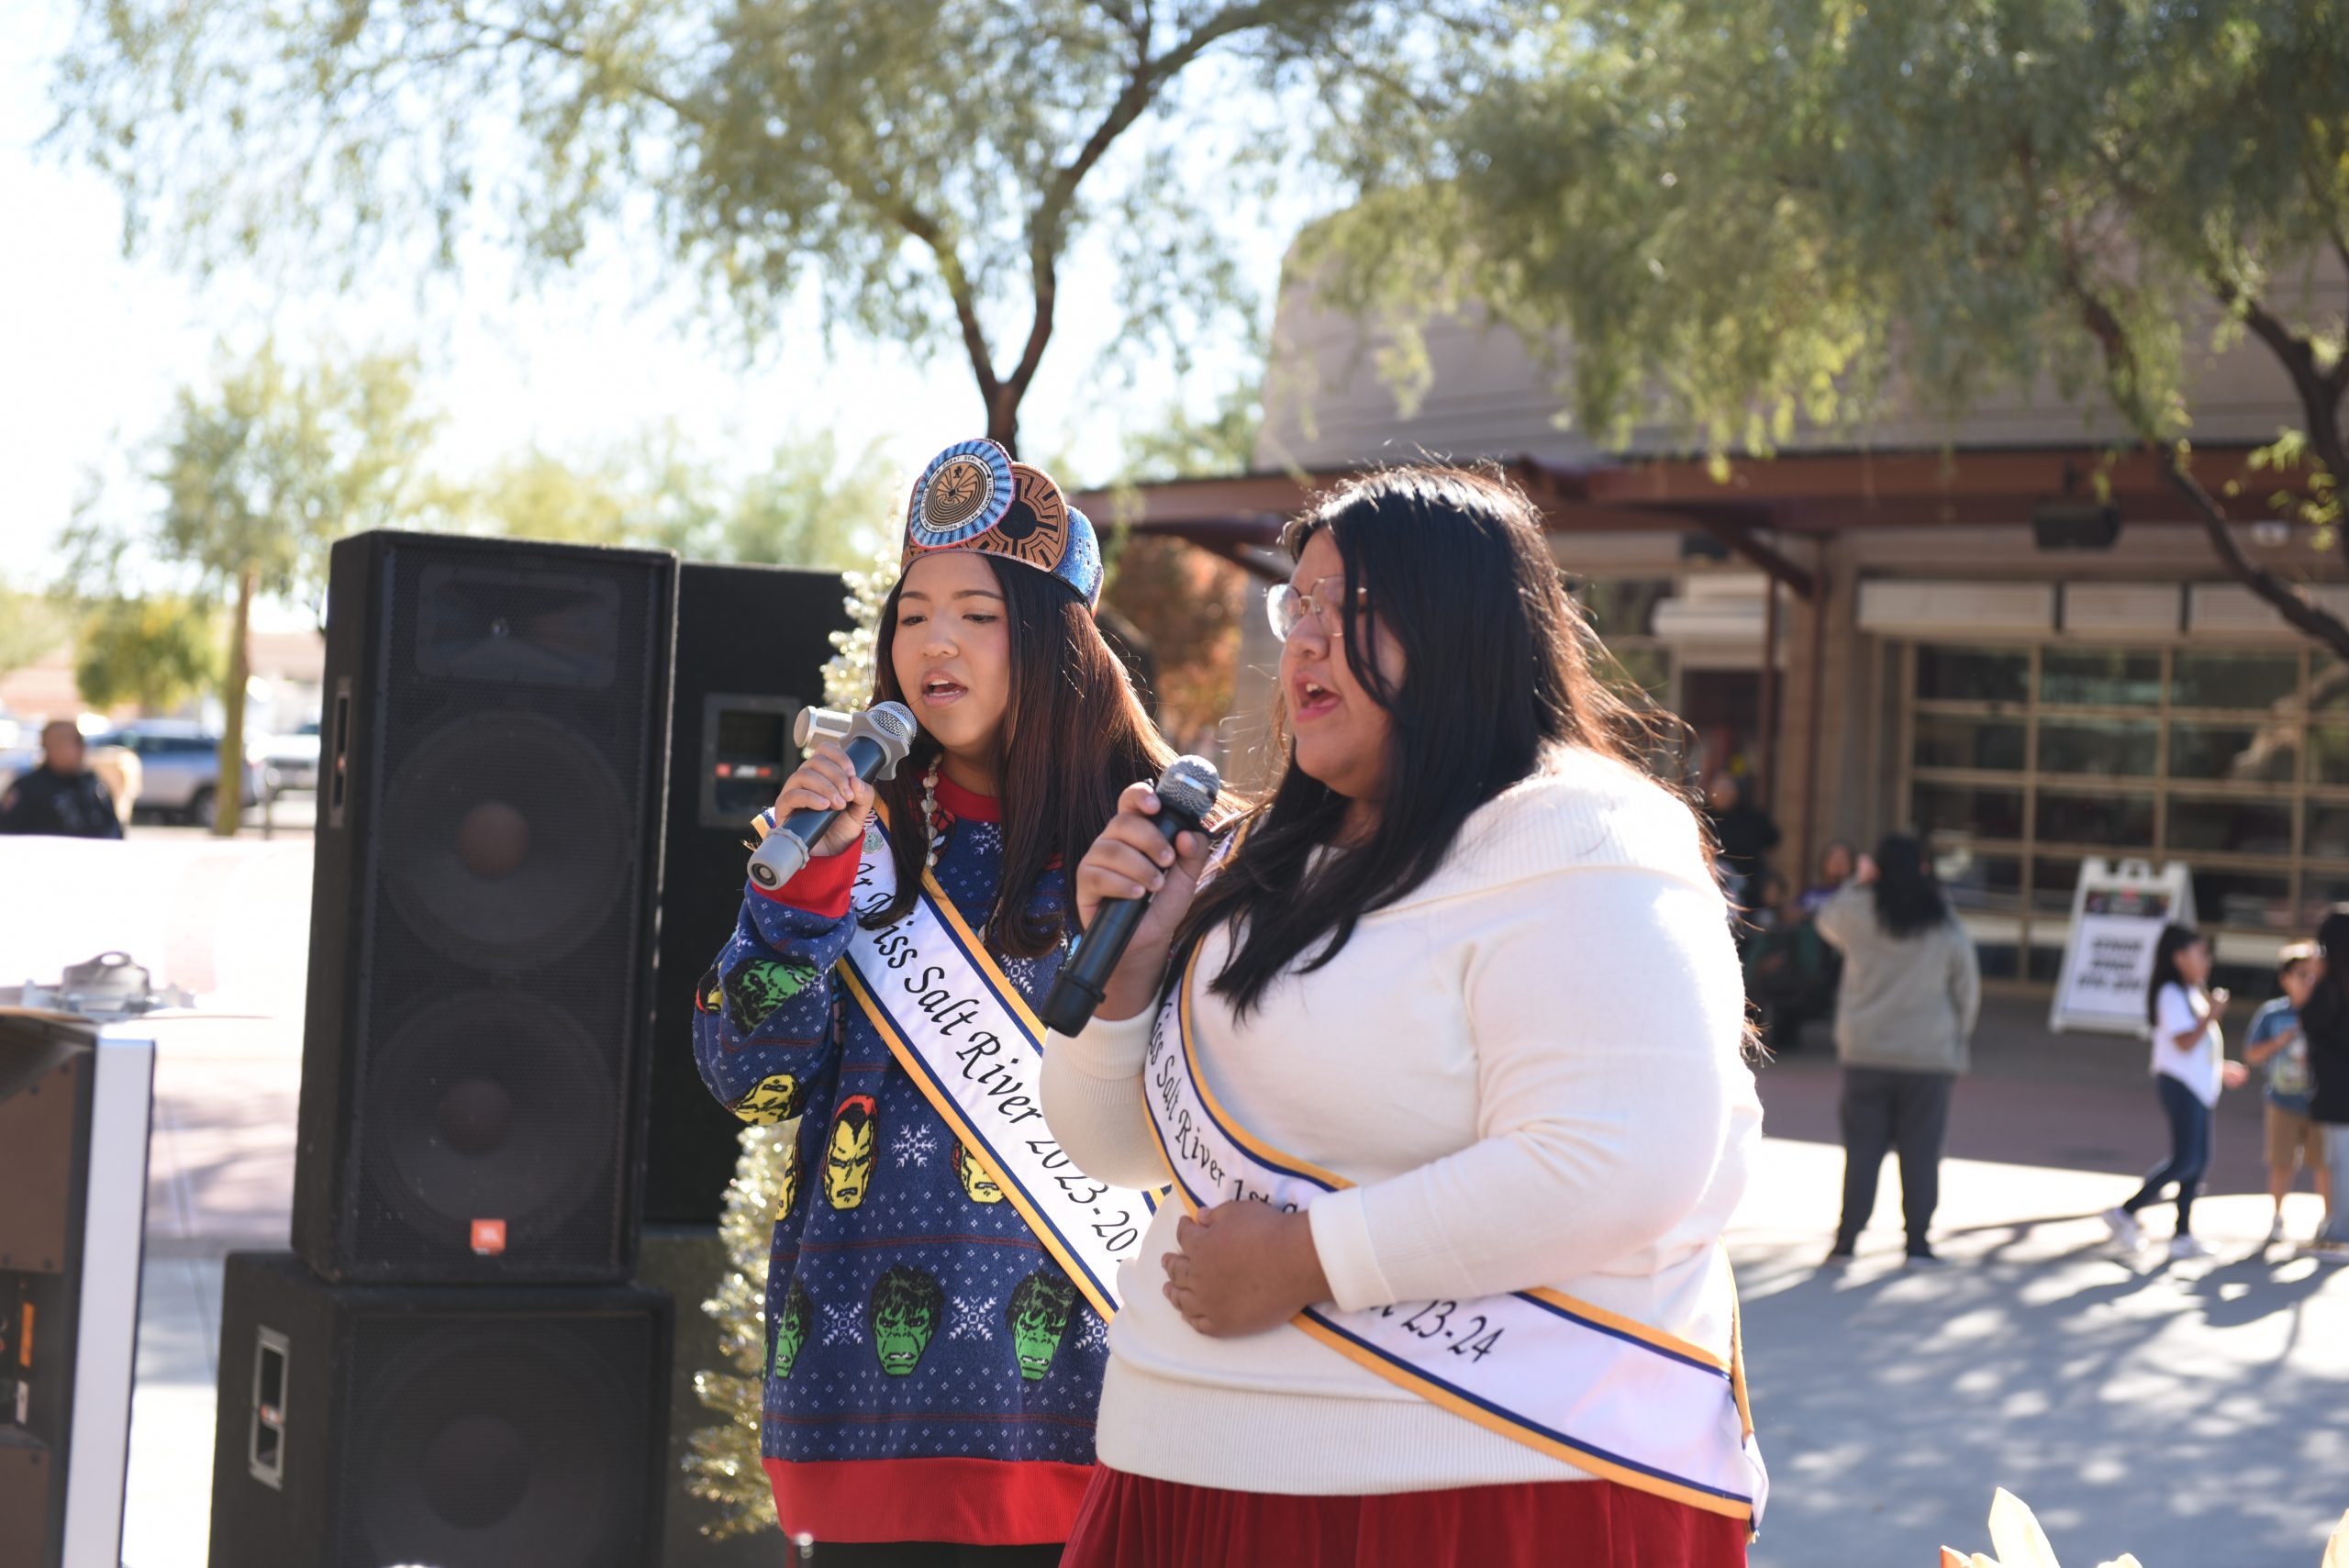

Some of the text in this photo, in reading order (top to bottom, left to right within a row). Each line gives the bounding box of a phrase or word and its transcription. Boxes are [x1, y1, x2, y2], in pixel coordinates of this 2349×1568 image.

[1150, 1002, 1173, 1066] iss
[903, 966, 980, 1036] Salt
[955, 1031, 1043, 1124] River
[1025, 1136, 1138, 1263] 2023-20
[1156, 1055, 1182, 1121] Salt
[1174, 1108, 1226, 1188] River
[1400, 1299, 1506, 1364] 23-24
